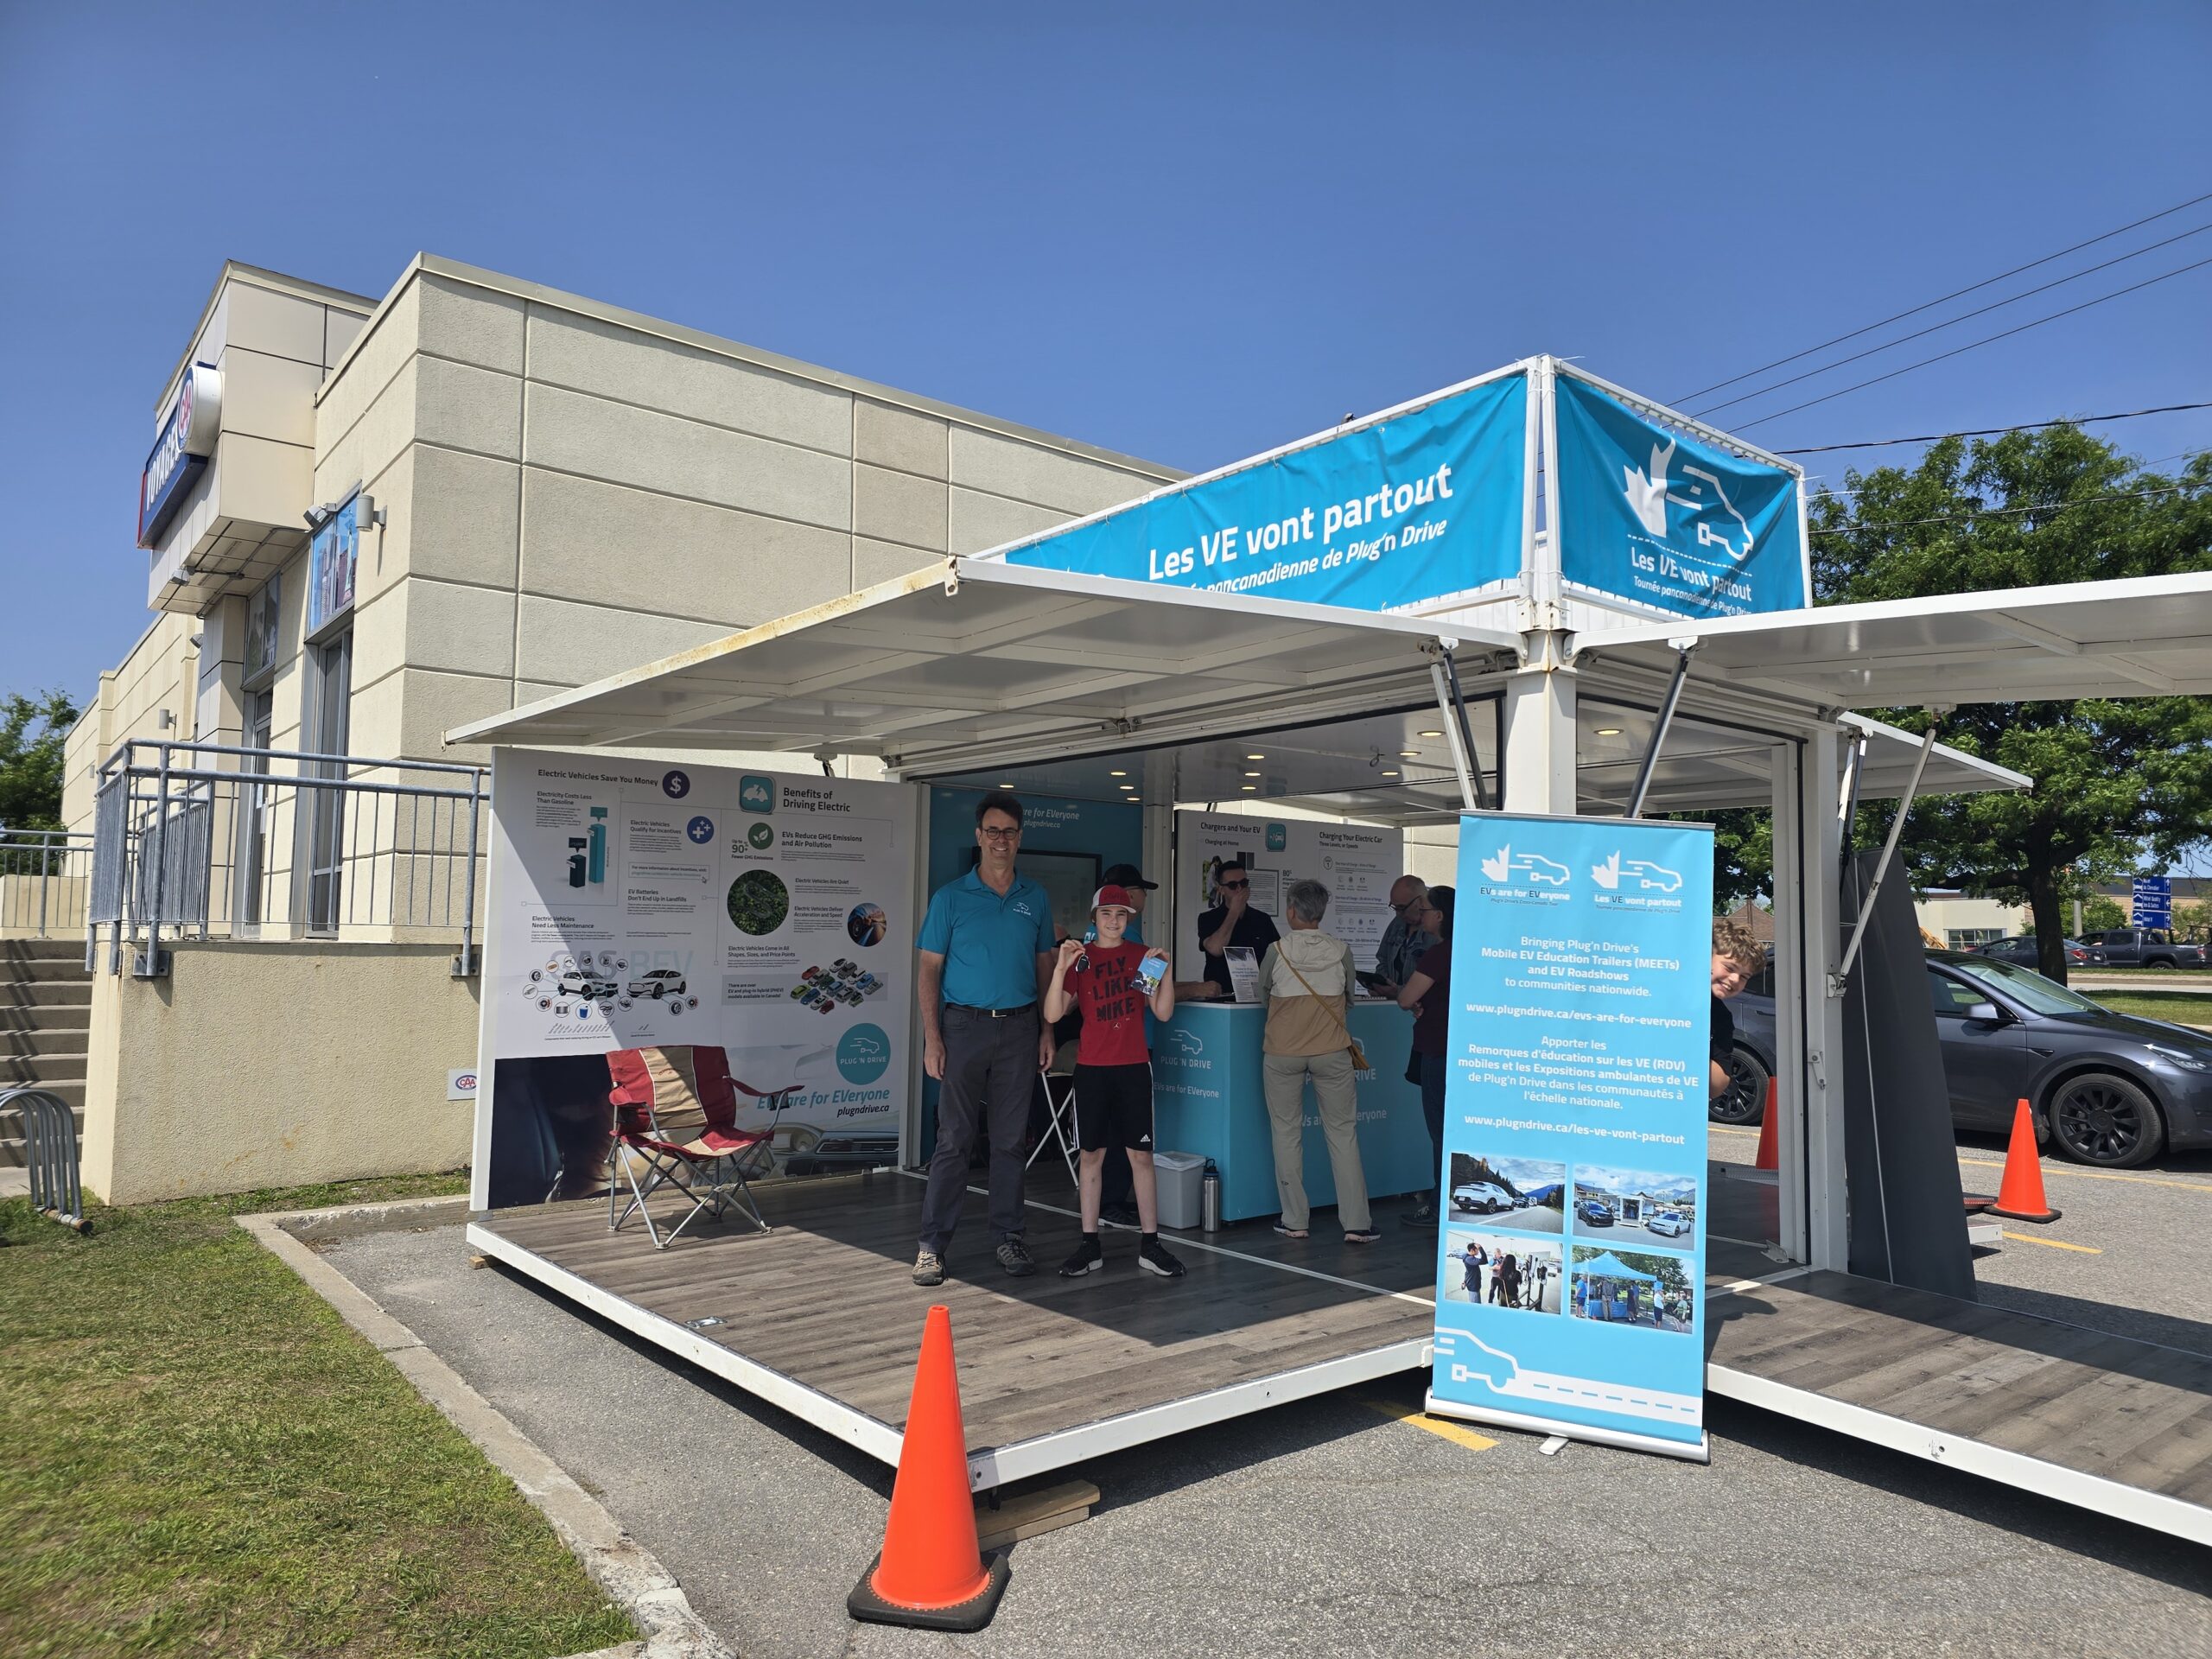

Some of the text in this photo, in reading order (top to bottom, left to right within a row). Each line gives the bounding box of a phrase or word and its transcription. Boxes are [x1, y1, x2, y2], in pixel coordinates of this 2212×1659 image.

[1149, 463, 1453, 581] Les VE vont partout
[1322, 548, 1342, 569] de
[1346, 534, 1396, 563] Plug'n
[1402, 518, 1447, 547] Drive
[1631, 547, 1751, 602] Les VE vont partout
[1634, 575, 1661, 594] Tournée
[1661, 585, 1710, 607] pancanadienne
[538, 769, 566, 778] Electric
[569, 772, 599, 780] Vehicles
[634, 777, 658, 786] Money
[783, 787, 833, 799] Benefits of
[783, 798, 851, 812] Driving Electric
[1033, 807, 1080, 821] for EVeryone
[1201, 822, 1226, 832] Chargers
[795, 832, 817, 841] Reduce
[1319, 831, 1342, 842] Charging
[1480, 887, 1571, 902] EVs are for EVeryone
[1594, 893, 1681, 908] Les VE vont partout
[1521, 936, 1639, 954] Bringing Plug'n Drive's
[1095, 956, 1126, 979] FLY
[1481, 947, 1680, 971] Mobile EV Education Trailers (MEETs)
[1528, 964, 1630, 981] and EV Roadshows
[1504, 977, 1651, 996] to communities nationwide.
[1096, 997, 1135, 1021] MIKE
[1466, 1001, 1692, 1028] www.plugndrive.ca/evs-are-for-everyone
[1541, 1036, 1606, 1050] Apporter les
[1160, 1055, 1211, 1070] PLUG 'N DRIVE
[1468, 1044, 1685, 1072] Remorques d'éducation sur les VE (RDV)
[1355, 1068, 1376, 1081] RIVE
[1458, 1057, 1699, 1087] mobiles et les Expositions ambulantes de VE
[460, 1077, 475, 1088] CAA
[1154, 1083, 1165, 1091] EVs
[1177, 1084, 1186, 1094] for
[1187, 1086, 1219, 1098] EVeryone
[1468, 1071, 1684, 1100] de Plug'n Drive dans les communautés à
[810, 1092, 830, 1108] for
[832, 1088, 890, 1106] EVeryone
[1523, 1090, 1624, 1109] l'échelle nationale.
[836, 1104, 890, 1118] plugndrive.ca
[1464, 1114, 1685, 1145] www.plugndrive.ca/les-ve-vont-partout
